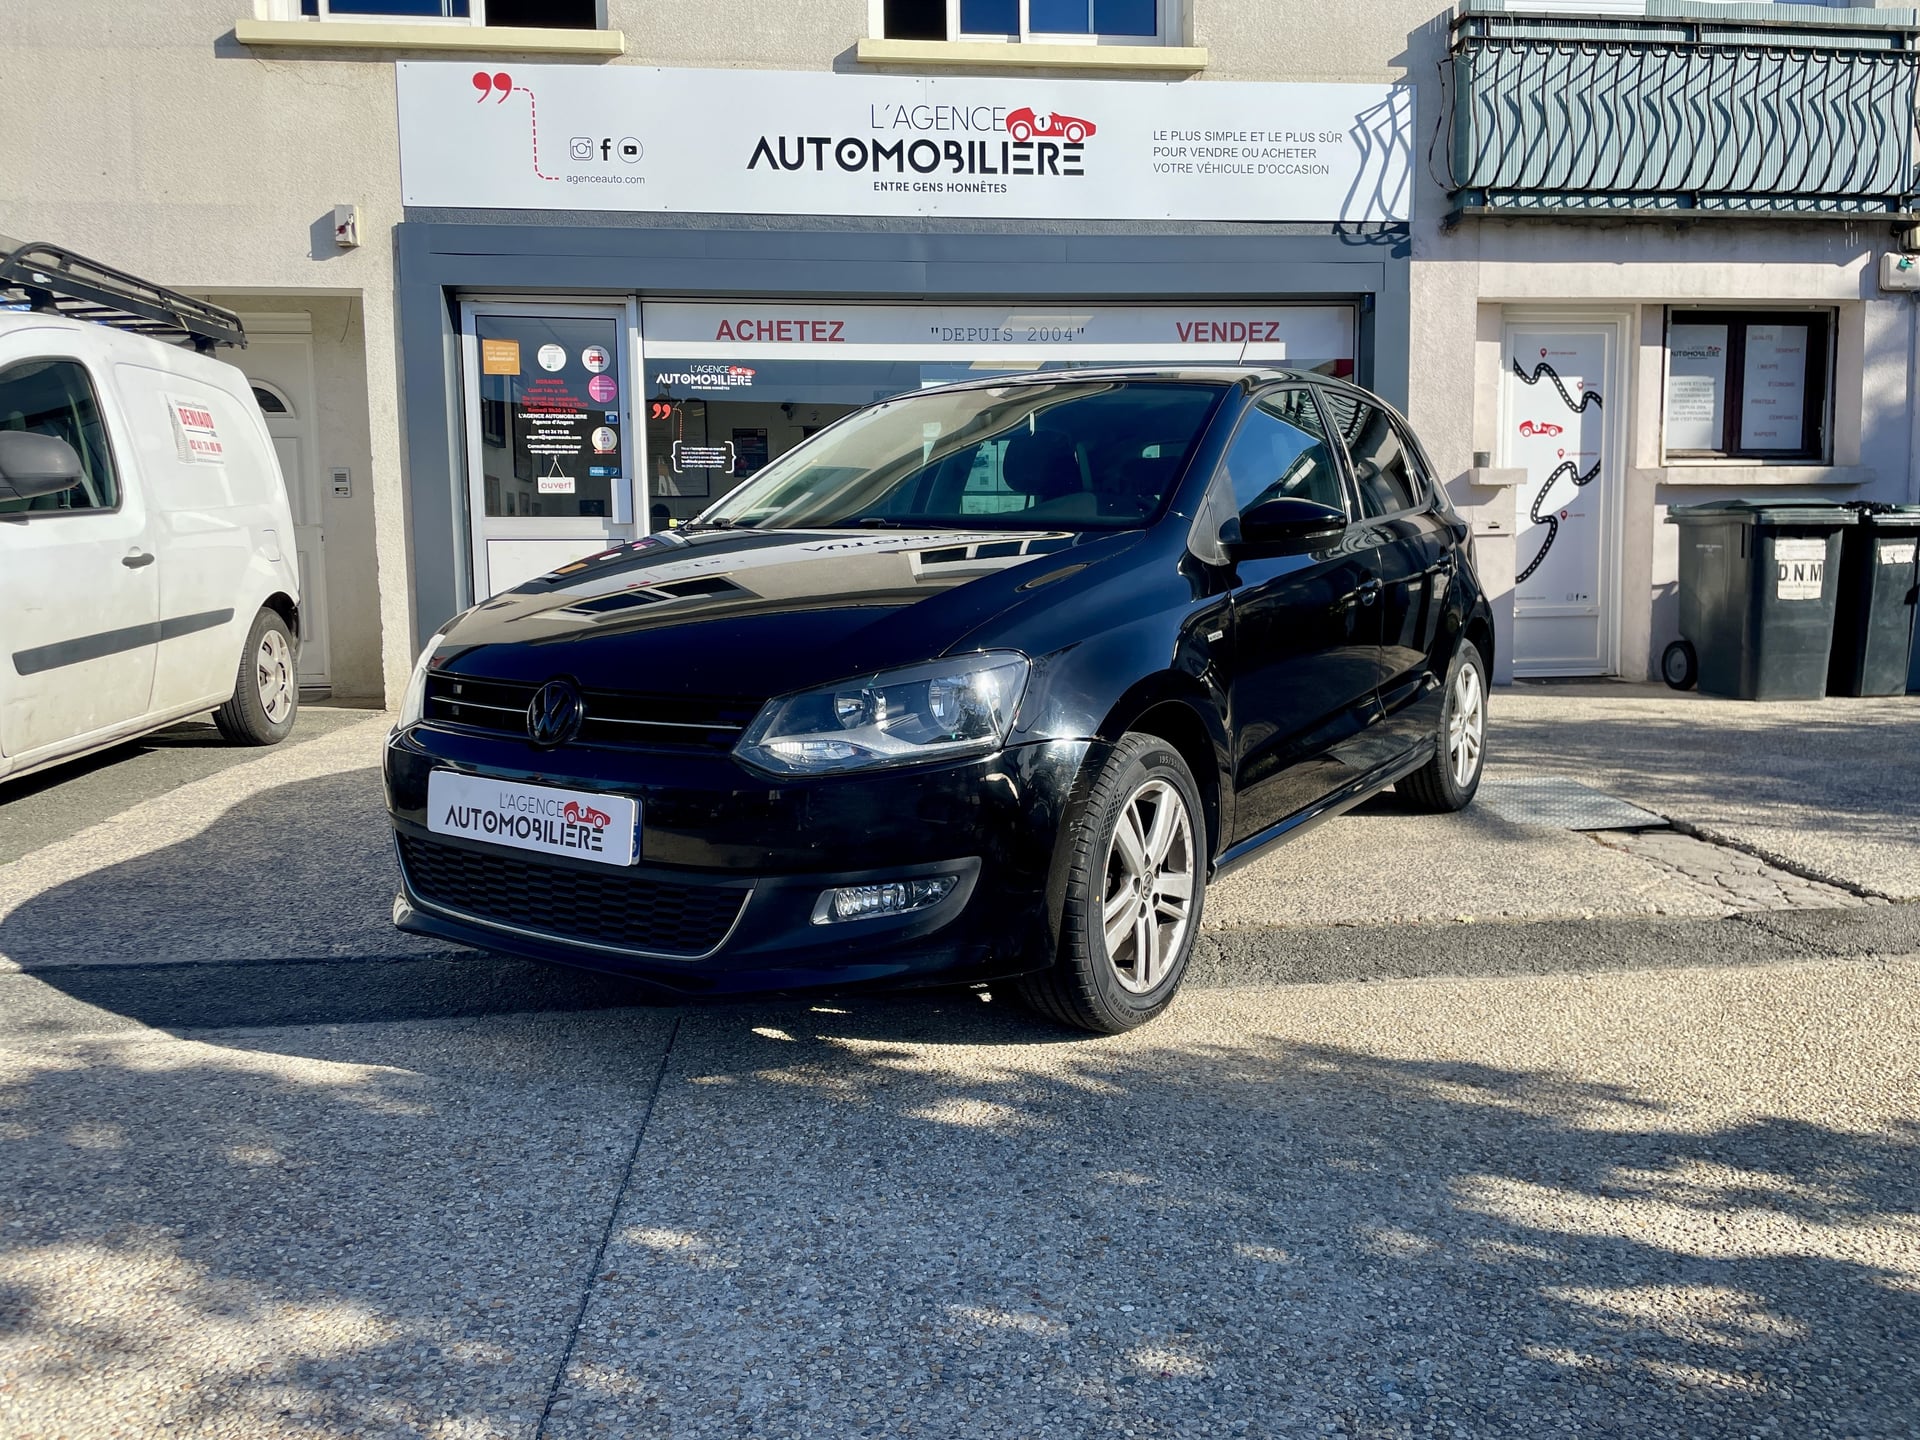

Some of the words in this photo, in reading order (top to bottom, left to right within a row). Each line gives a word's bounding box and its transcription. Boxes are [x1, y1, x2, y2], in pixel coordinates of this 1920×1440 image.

[871, 103, 1007, 132] L'AGENCE
[1153, 130, 1168, 142] LE
[1170, 130, 1202, 142] PLUS
[1204, 130, 1248, 143] SIMPLE
[1250, 131, 1266, 143] ET
[1268, 131, 1283, 143] LE
[1285, 131, 1316, 143] PLUS
[1318, 129, 1343, 143] SÛR
[1153, 146, 1192, 158] POUR
[1194, 147, 1240, 159] VENDRE
[1241, 147, 1260, 159] OU
[1260, 147, 1318, 159] ACHETER
[1153, 162, 1194, 174] VOTRE
[1196, 161, 1256, 175] VÉHICULE
[1257, 163, 1331, 175] D'OCCASION
[565, 173, 646, 187] agenceauto.com
[873, 181, 910, 193] ENTRE
[912, 182, 944, 193] GENS
[945, 180, 1008, 194] HONNÊTES
[716, 319, 845, 342] ACHETEZ
[930, 326, 1014, 342] "DEPUIS
[1026, 327, 1085, 342] 2004"
[1176, 321, 1280, 342] VENDEZ
[690, 364, 729, 374] L'AGENCE
[540, 480, 573, 490] ouvert
[499, 791, 565, 819] L'AGENCE
